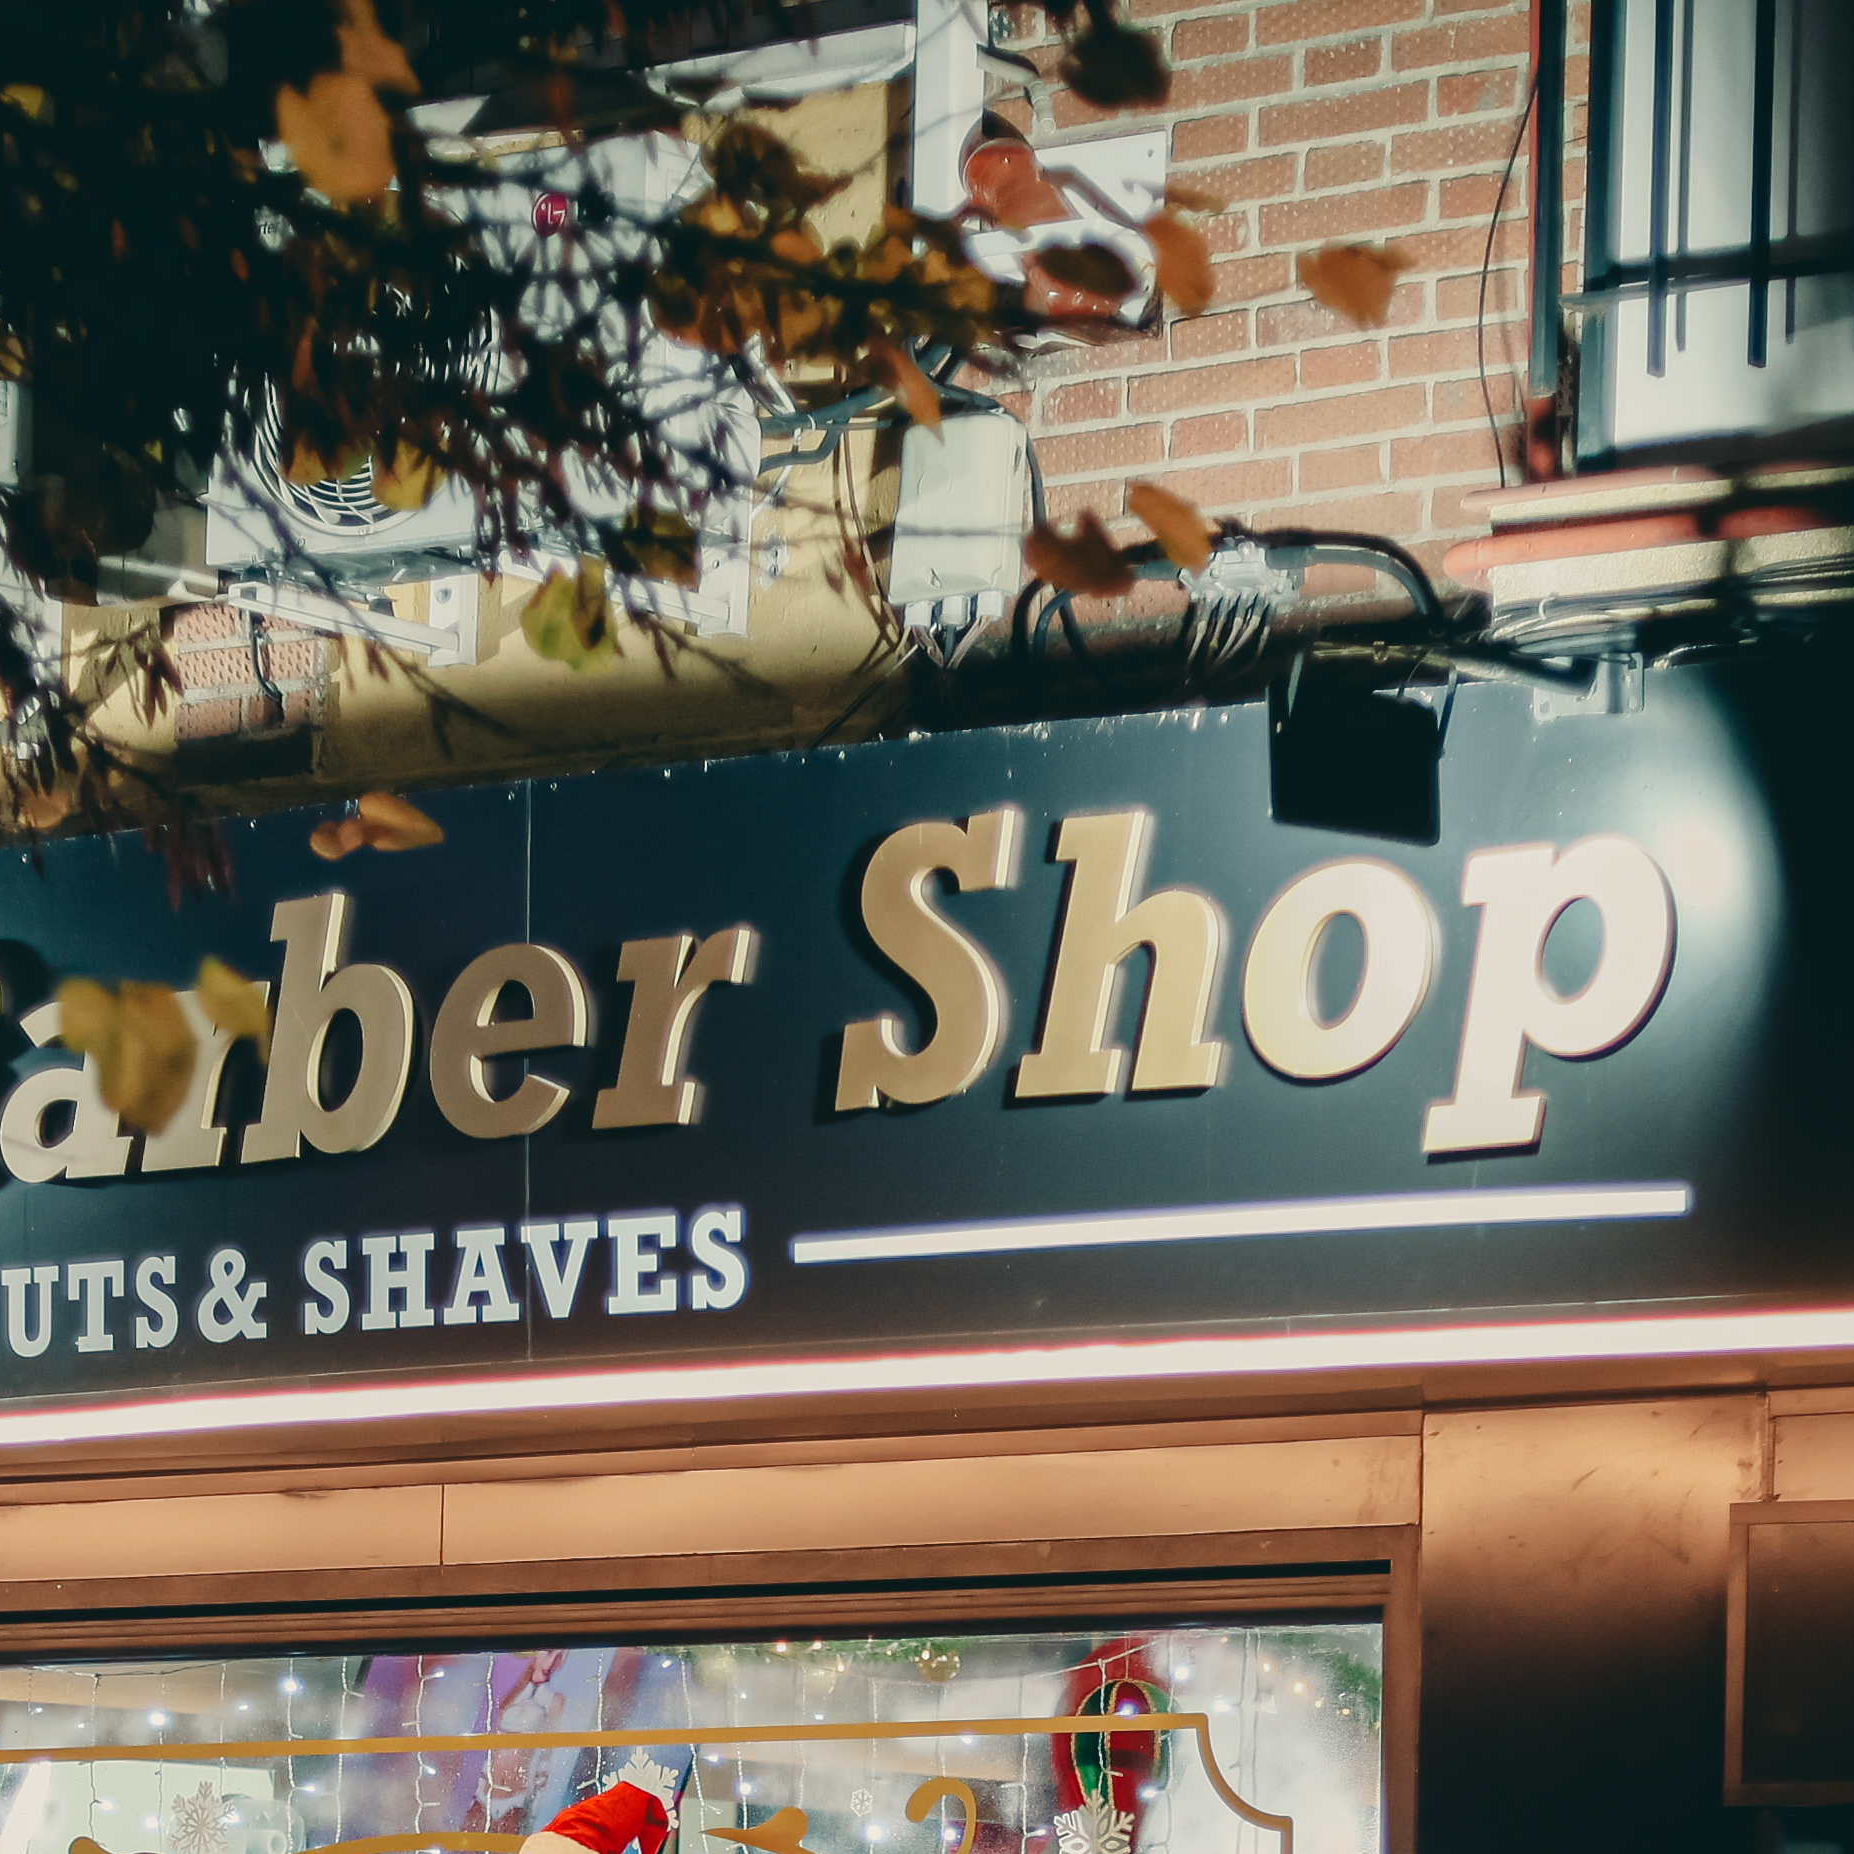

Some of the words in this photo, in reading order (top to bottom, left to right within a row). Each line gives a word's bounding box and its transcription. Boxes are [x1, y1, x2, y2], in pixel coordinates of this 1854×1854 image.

[834, 806, 1674, 1154] Shop
[197, 1248, 268, 1343] &
[303, 1207, 745, 1336] SHAVES
